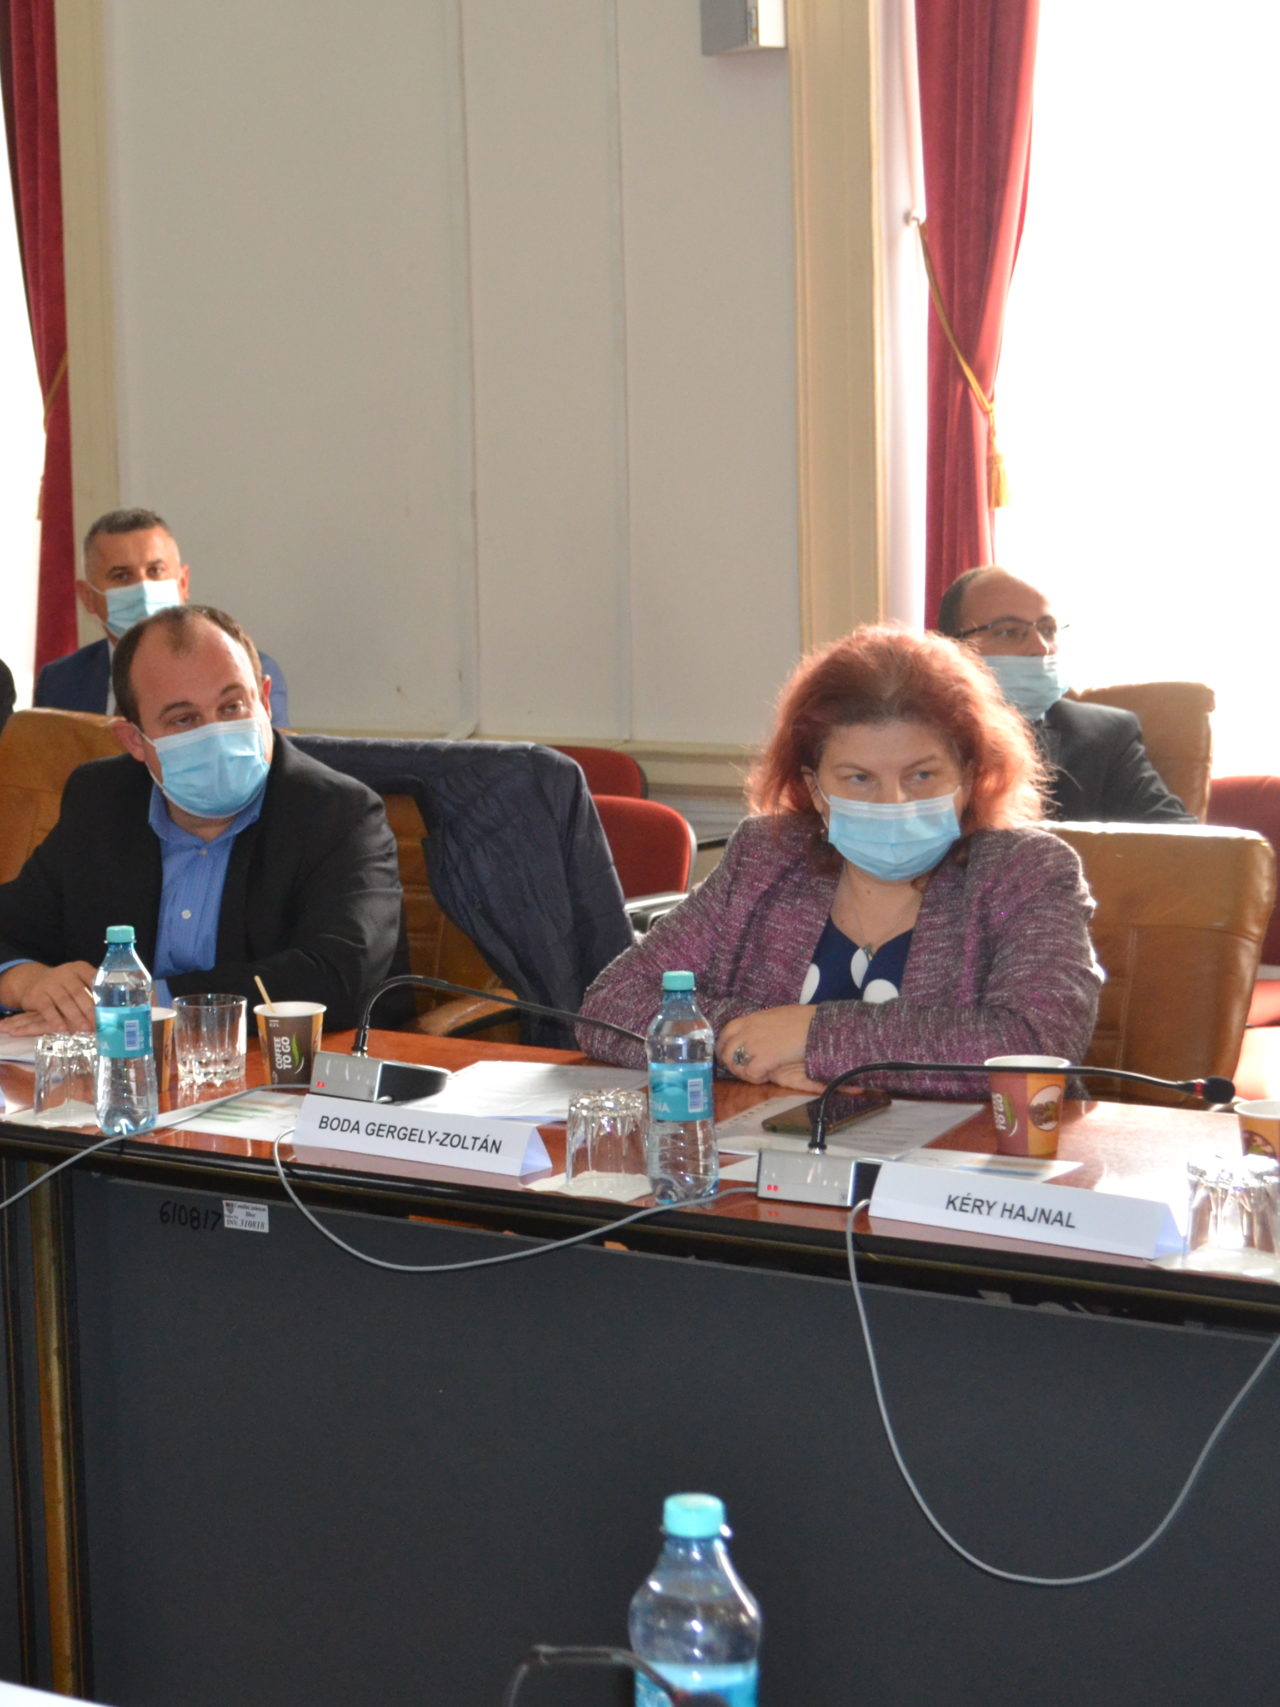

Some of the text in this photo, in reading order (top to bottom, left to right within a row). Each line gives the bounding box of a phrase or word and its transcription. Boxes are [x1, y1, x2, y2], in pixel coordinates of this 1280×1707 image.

[281, 1036, 292, 1070] TO GO
[318, 1115, 502, 1155] BODA GERGELY-ZOLTÁN
[945, 1193, 1076, 1229] KÉRY HAJNAL
